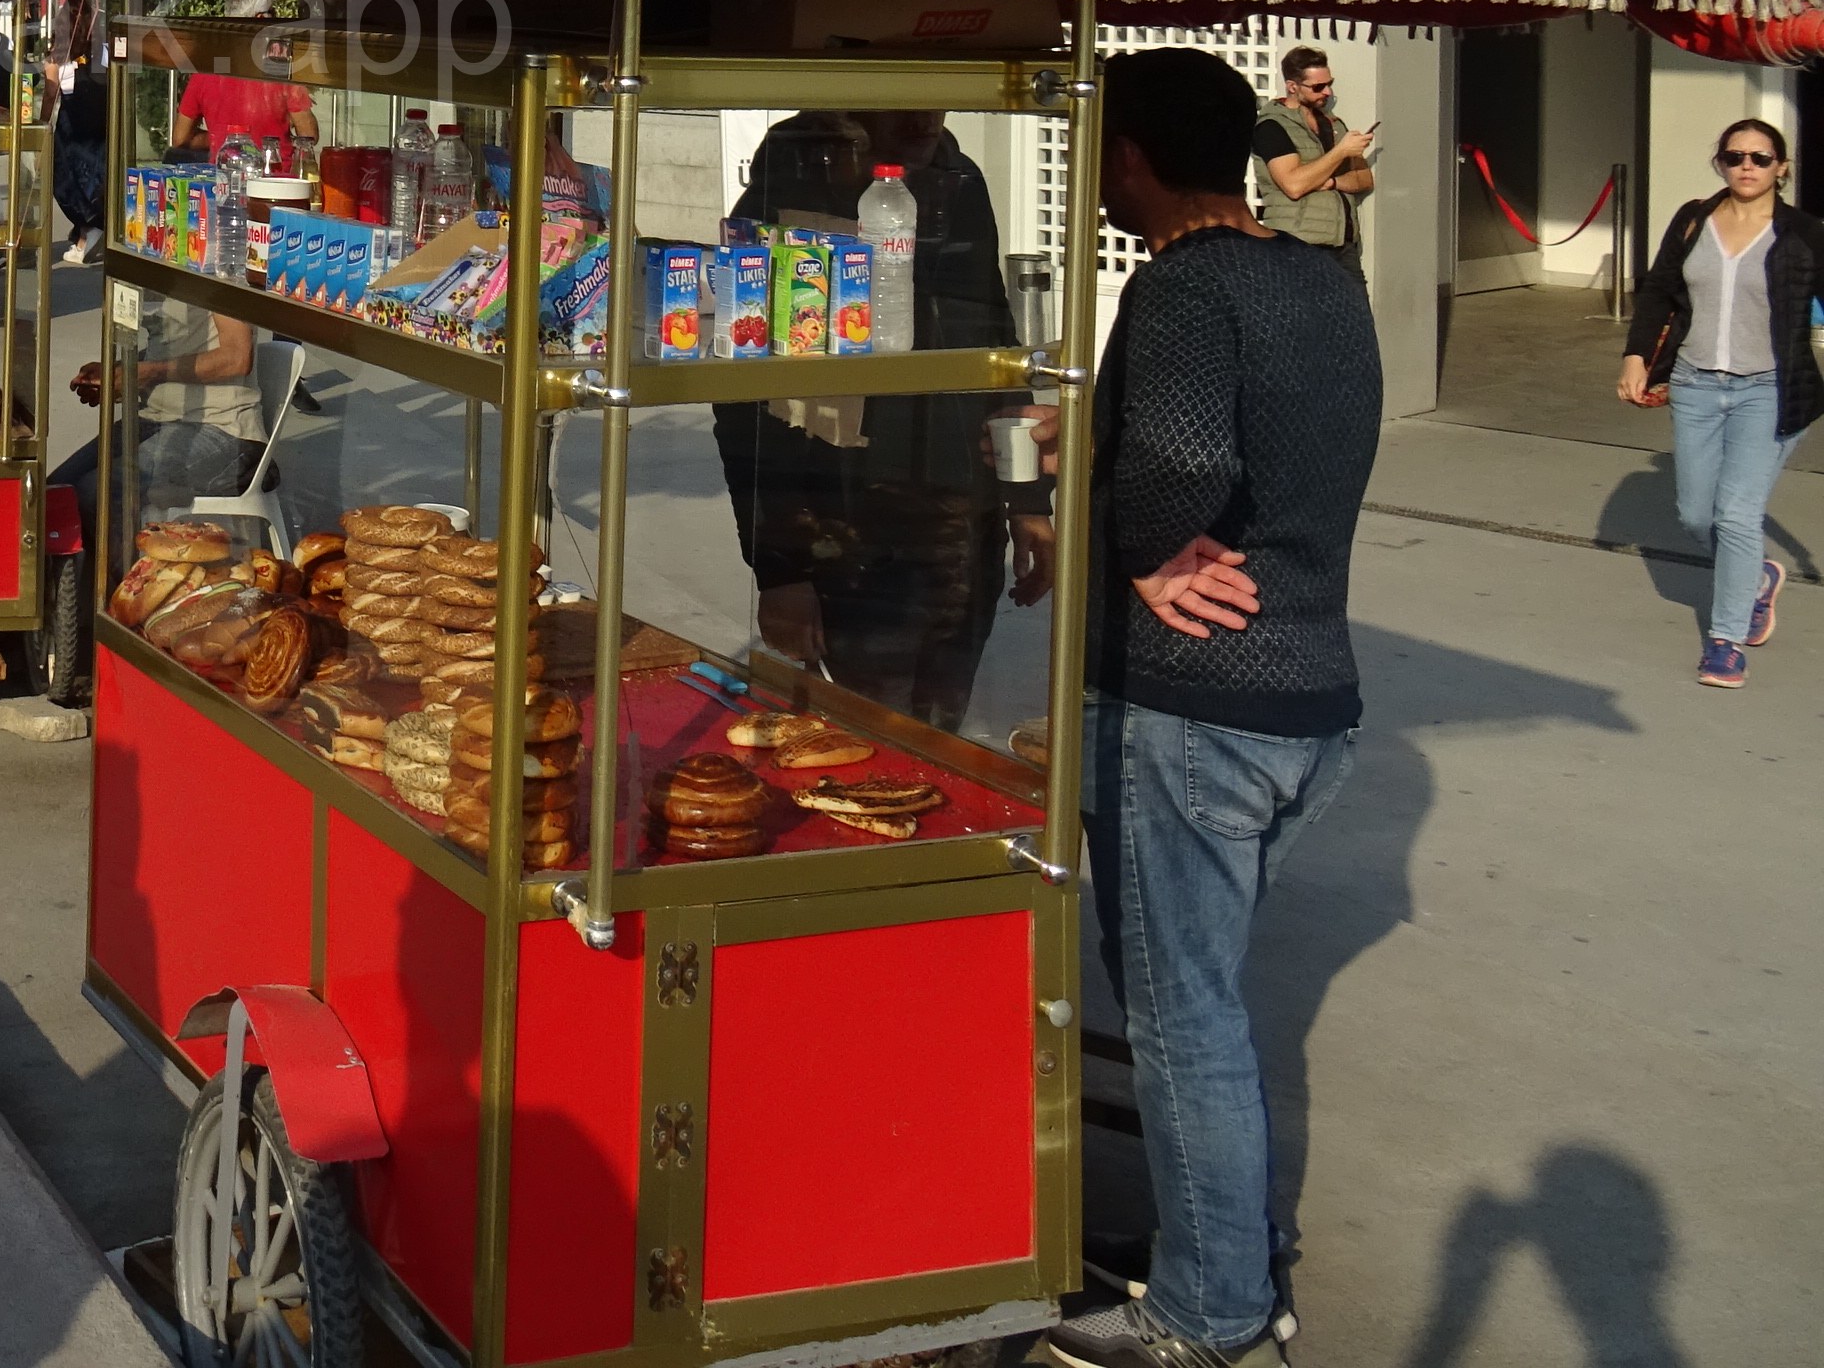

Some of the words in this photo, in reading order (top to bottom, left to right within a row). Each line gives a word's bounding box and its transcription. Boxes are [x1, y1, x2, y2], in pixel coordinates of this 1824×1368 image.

[432, 183, 467, 196] HAYAT
[669, 257, 695, 268] DİMES
[740, 256, 763, 267] DİMES
[845, 254, 867, 263] DİMES
[667, 269, 698, 288] STAR
